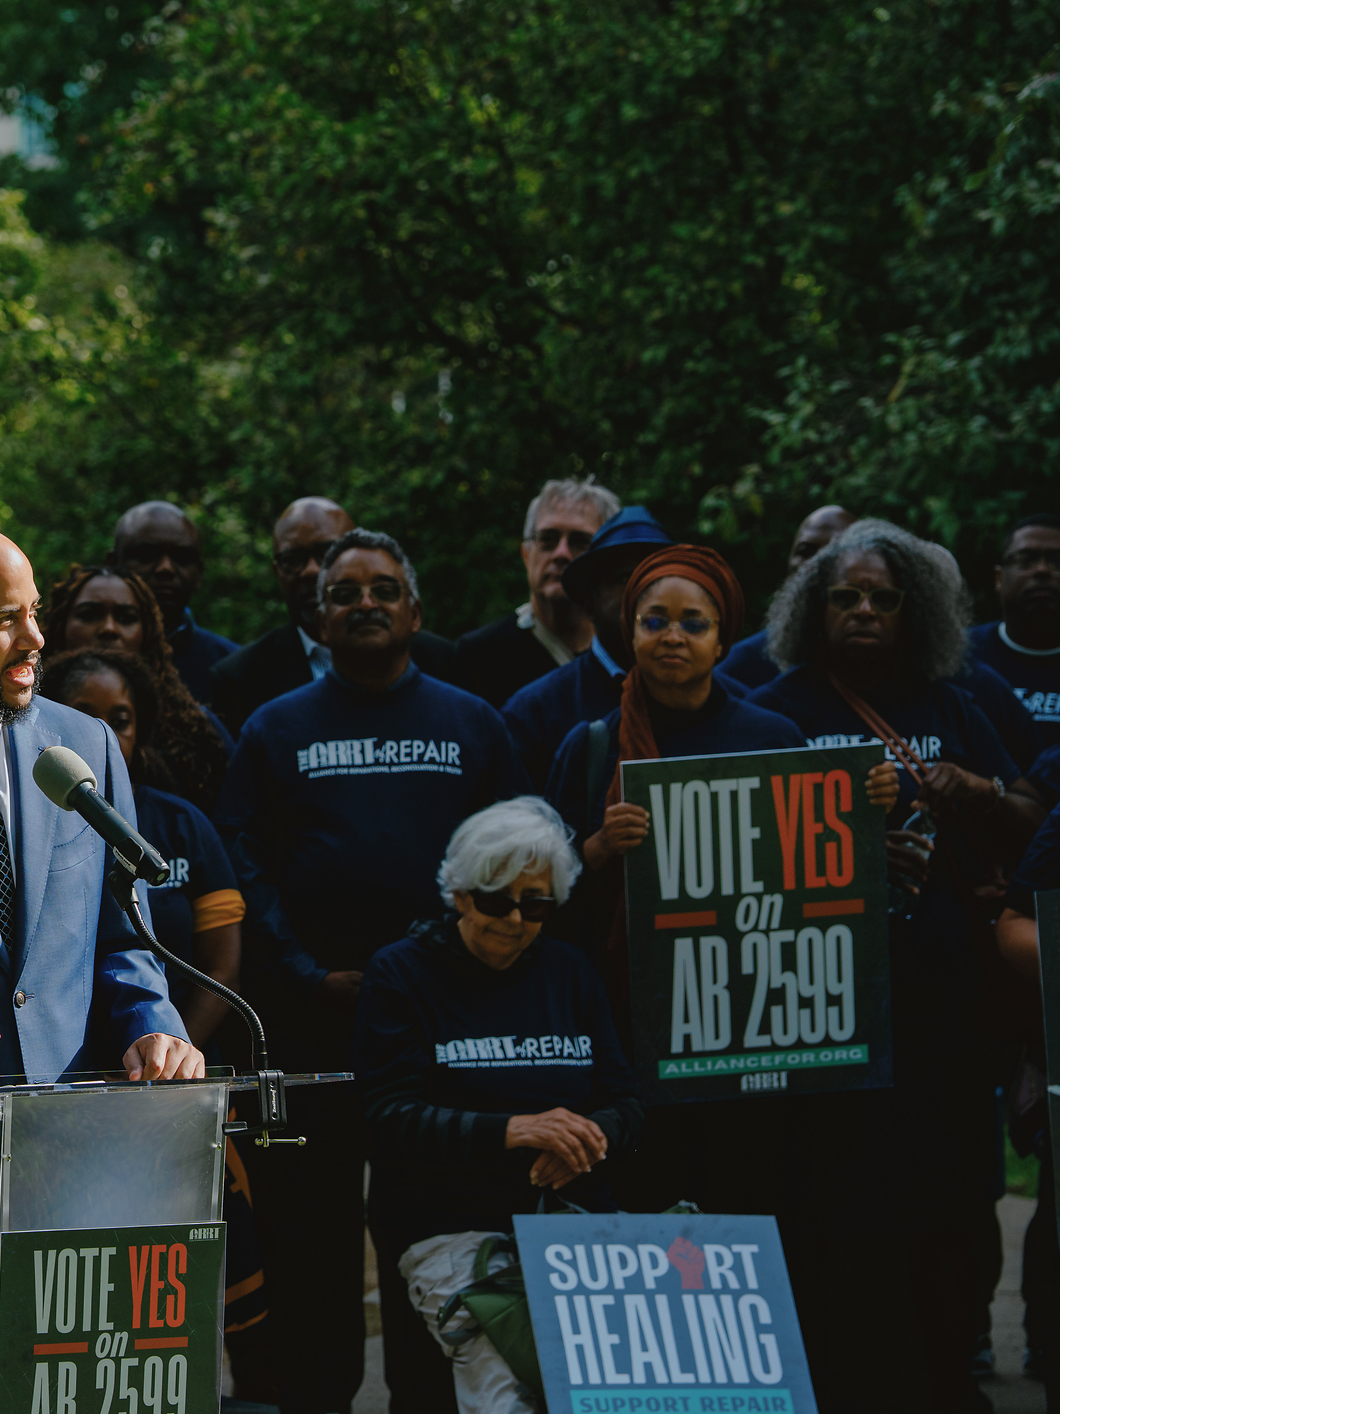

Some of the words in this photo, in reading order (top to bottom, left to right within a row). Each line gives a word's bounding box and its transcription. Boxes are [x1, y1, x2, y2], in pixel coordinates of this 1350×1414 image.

[1029, 691, 1060, 714] RE
[385, 739, 461, 766] REPAIR
[649, 776, 765, 901] VOTE
[770, 769, 855, 891] YES
[166, 857, 190, 883] IR
[735, 892, 784, 933] on
[670, 935, 732, 1054] AB
[741, 924, 856, 1049] 2599
[525, 1034, 593, 1058] REPAIR
[33, 1247, 117, 1334] VOTE
[128, 1243, 188, 1329] YES
[95, 1331, 129, 1358] on
[554, 1294, 784, 1385] HEALING
[31, 1361, 78, 1414] AB
[95, 1354, 188, 1414] 2599
[579, 1396, 691, 1413] SUPPORT
[701, 1396, 788, 1413] REPAIR
